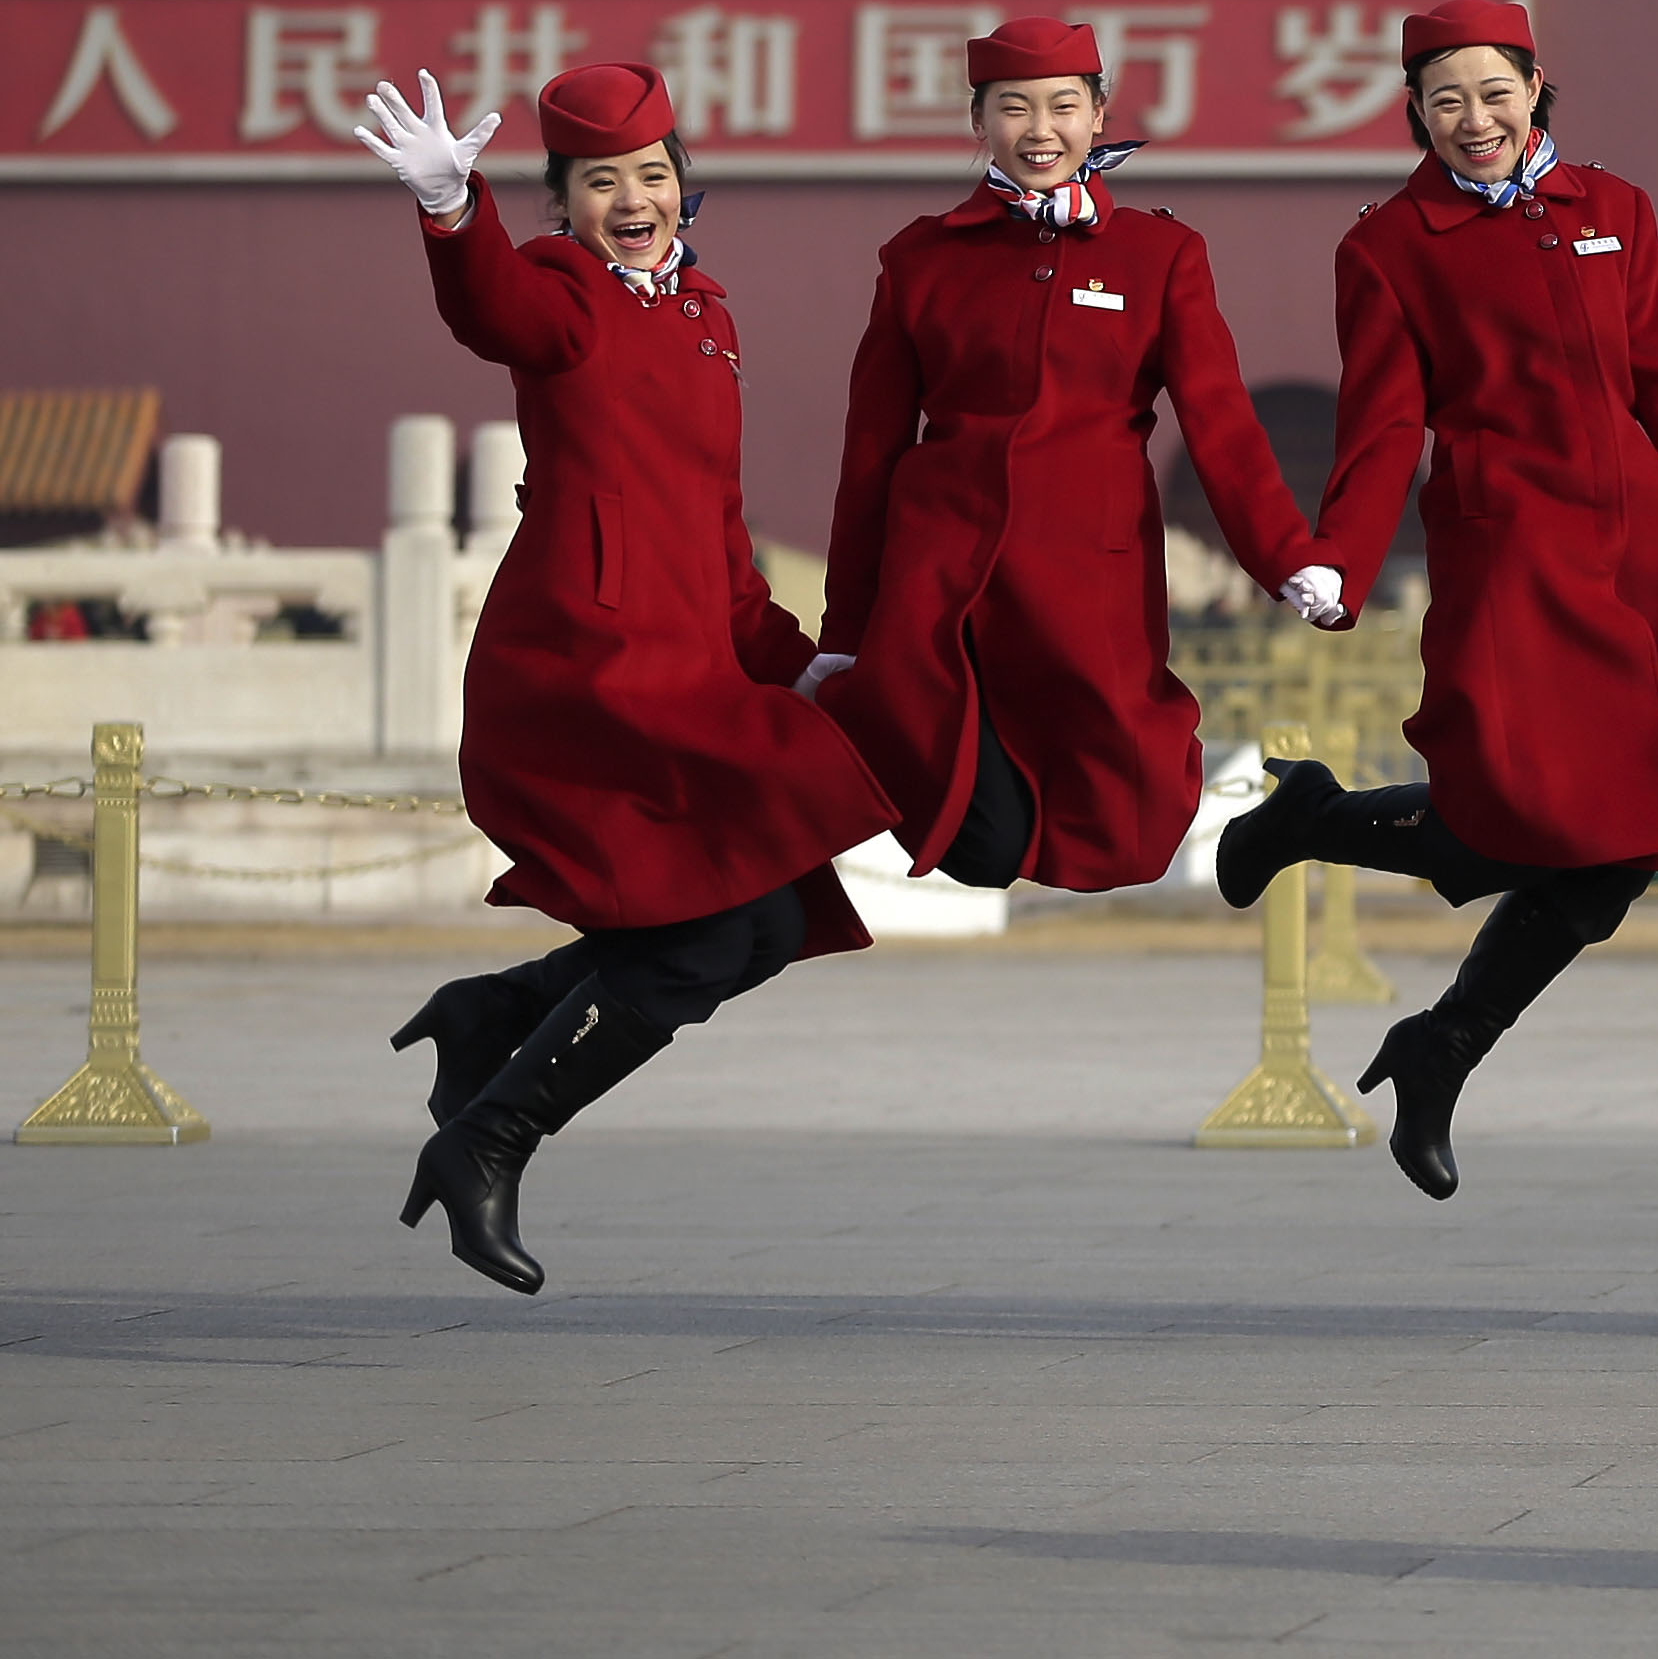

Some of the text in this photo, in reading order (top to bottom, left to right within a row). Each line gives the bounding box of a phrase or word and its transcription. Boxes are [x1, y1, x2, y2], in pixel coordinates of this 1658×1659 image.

[38, 2, 1403, 142] 人民共和国万岁
